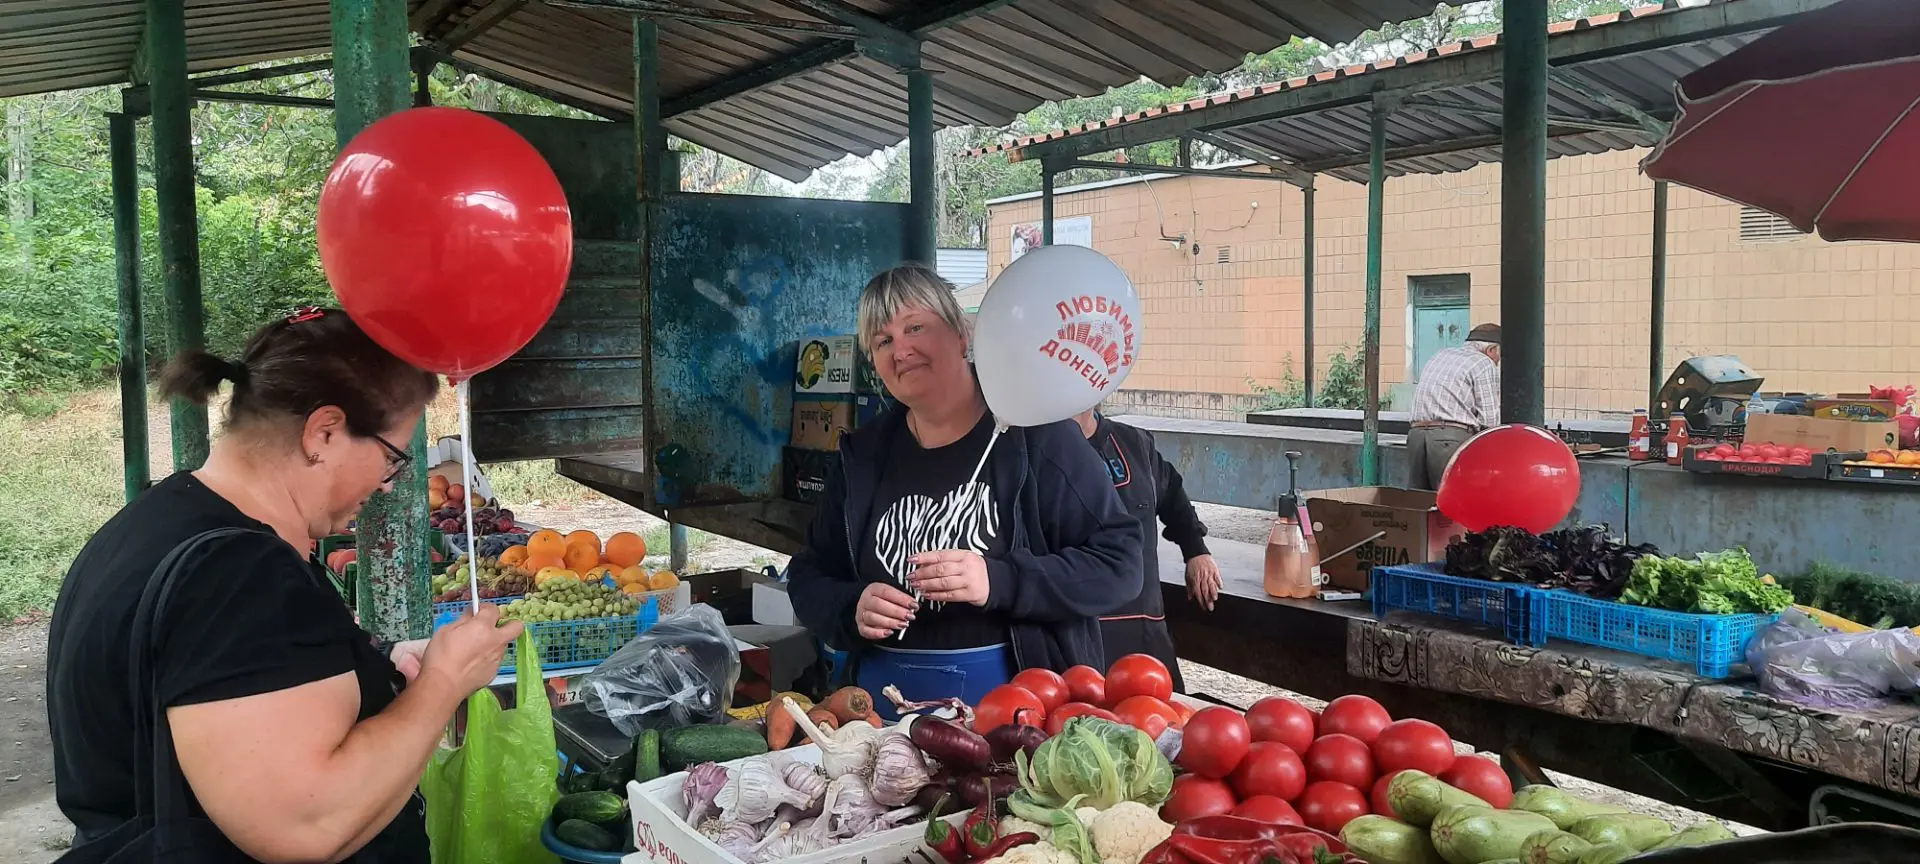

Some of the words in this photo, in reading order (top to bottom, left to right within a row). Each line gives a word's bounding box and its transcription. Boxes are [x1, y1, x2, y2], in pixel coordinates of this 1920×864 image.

[1055, 295, 1137, 367] ЛЮБИМЫЙ
[827, 368, 850, 383] FRESH
[1039, 338, 1110, 392] ДОНЕЦК
[1721, 463, 1782, 475] КРАСНОДАР
[1356, 541, 1410, 566] Village
